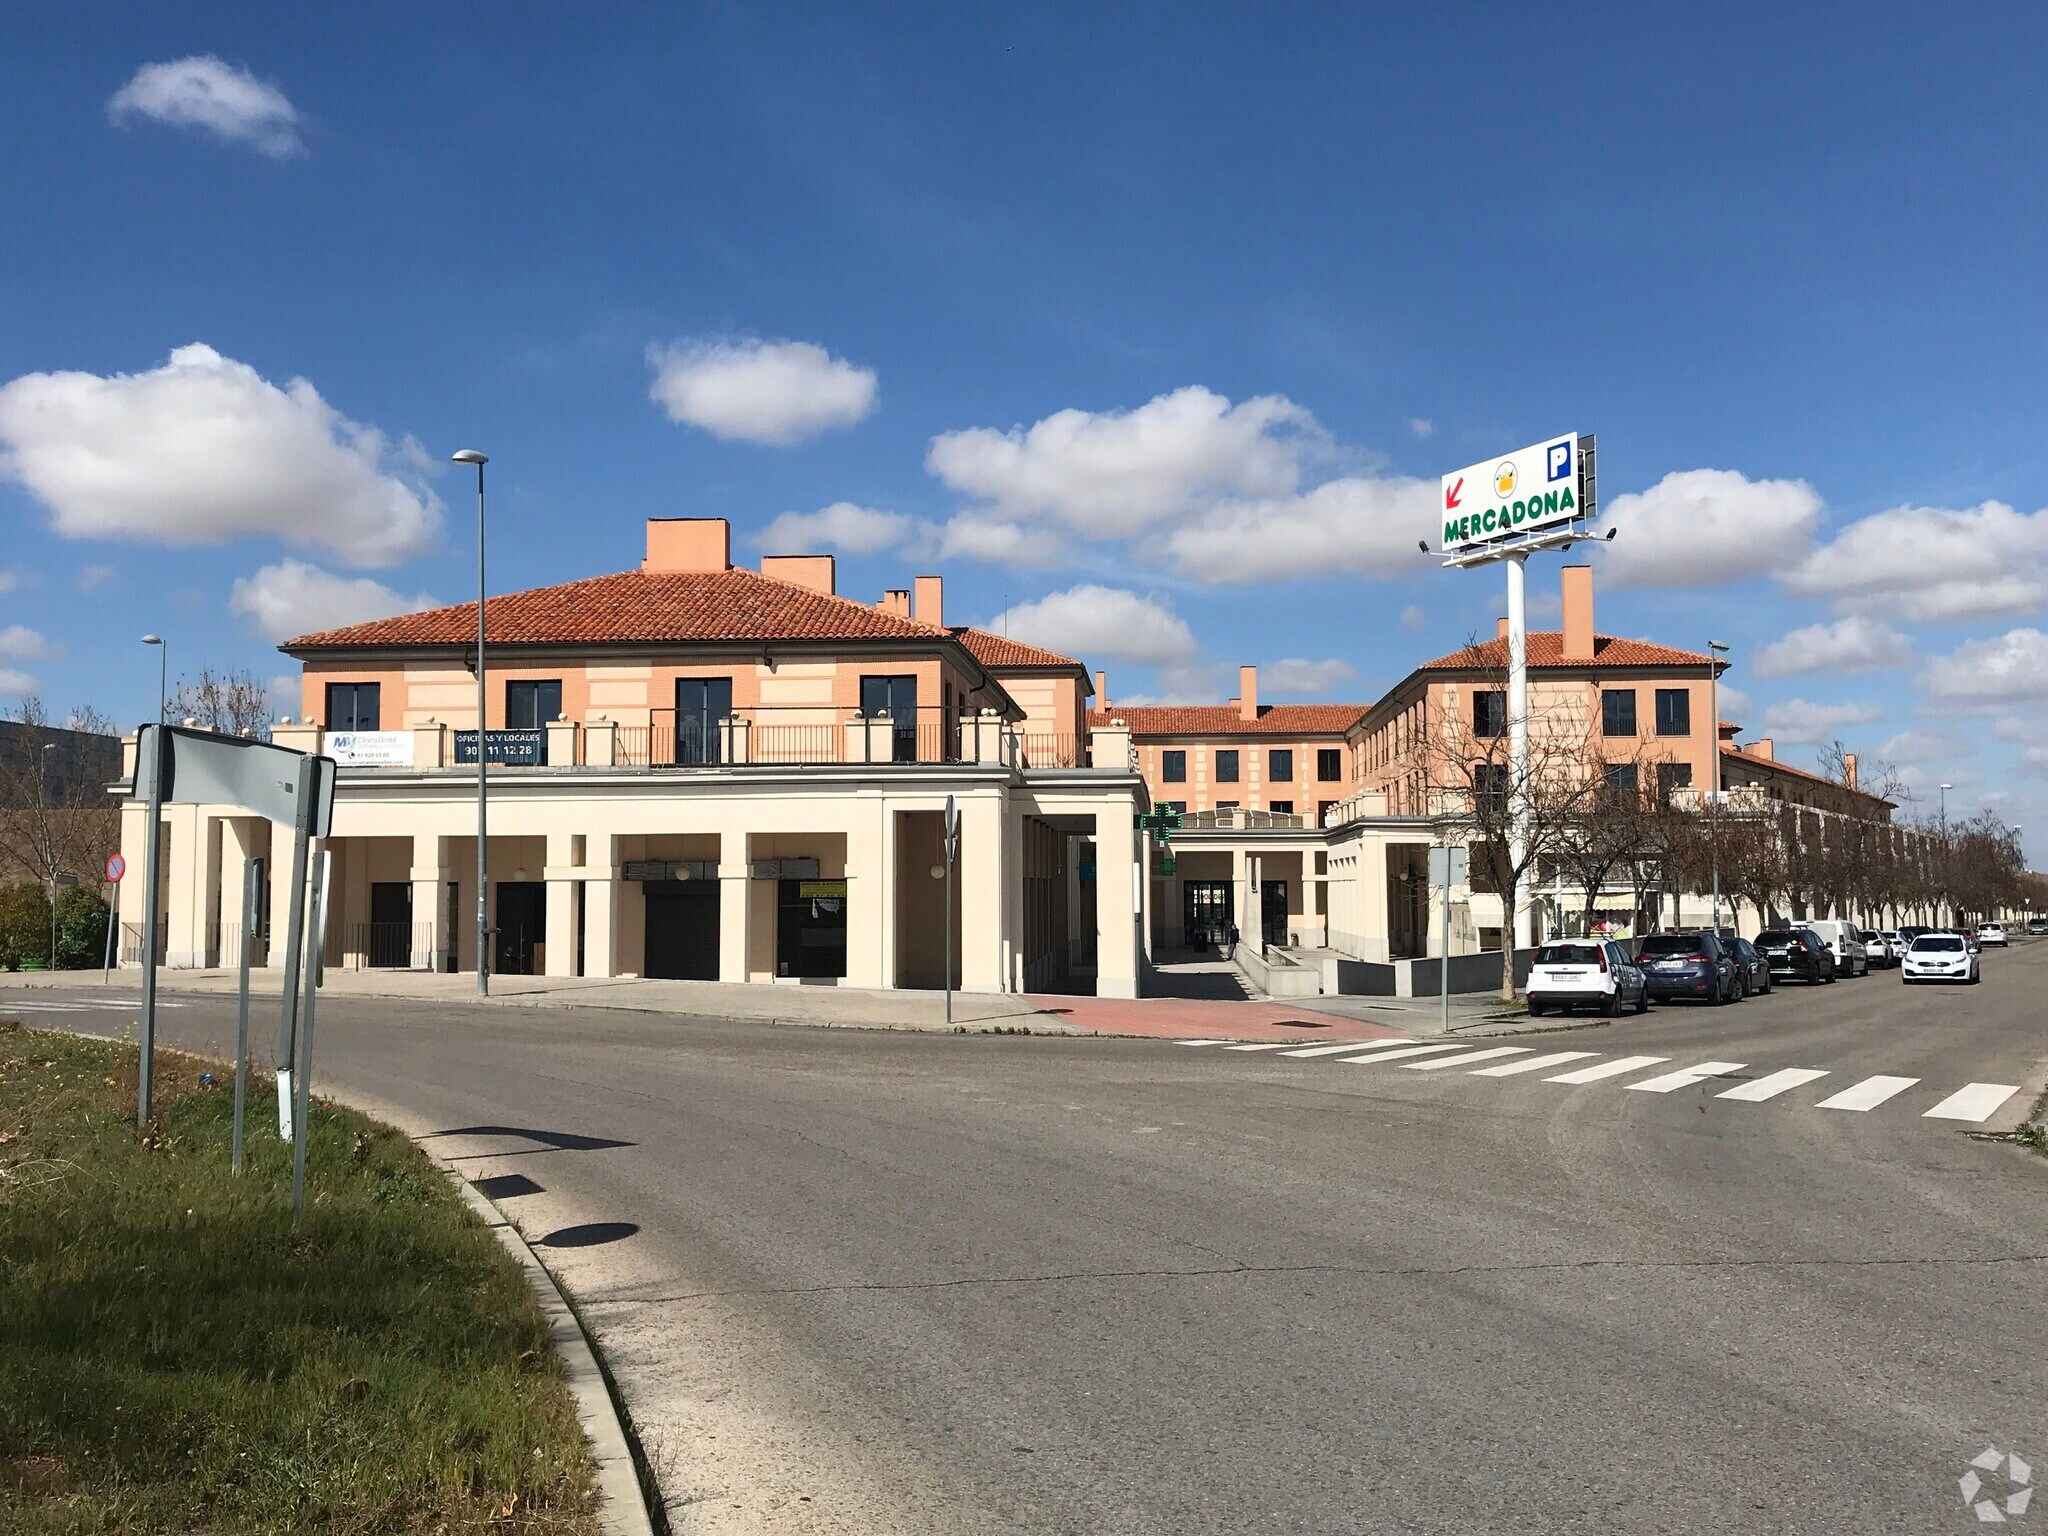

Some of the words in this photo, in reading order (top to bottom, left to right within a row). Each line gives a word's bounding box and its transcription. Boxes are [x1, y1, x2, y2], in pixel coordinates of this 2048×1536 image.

[1550, 446, 1568, 479] P
[1444, 486, 1575, 544] MERCADONA
[456, 734, 494, 742] OFICIAS
[496, 734, 502, 742] Y
[504, 734, 540, 742] LOCALES
[487, 746, 499, 755] 11
[503, 746, 516, 755] 12
[519, 746, 532, 755] 28
